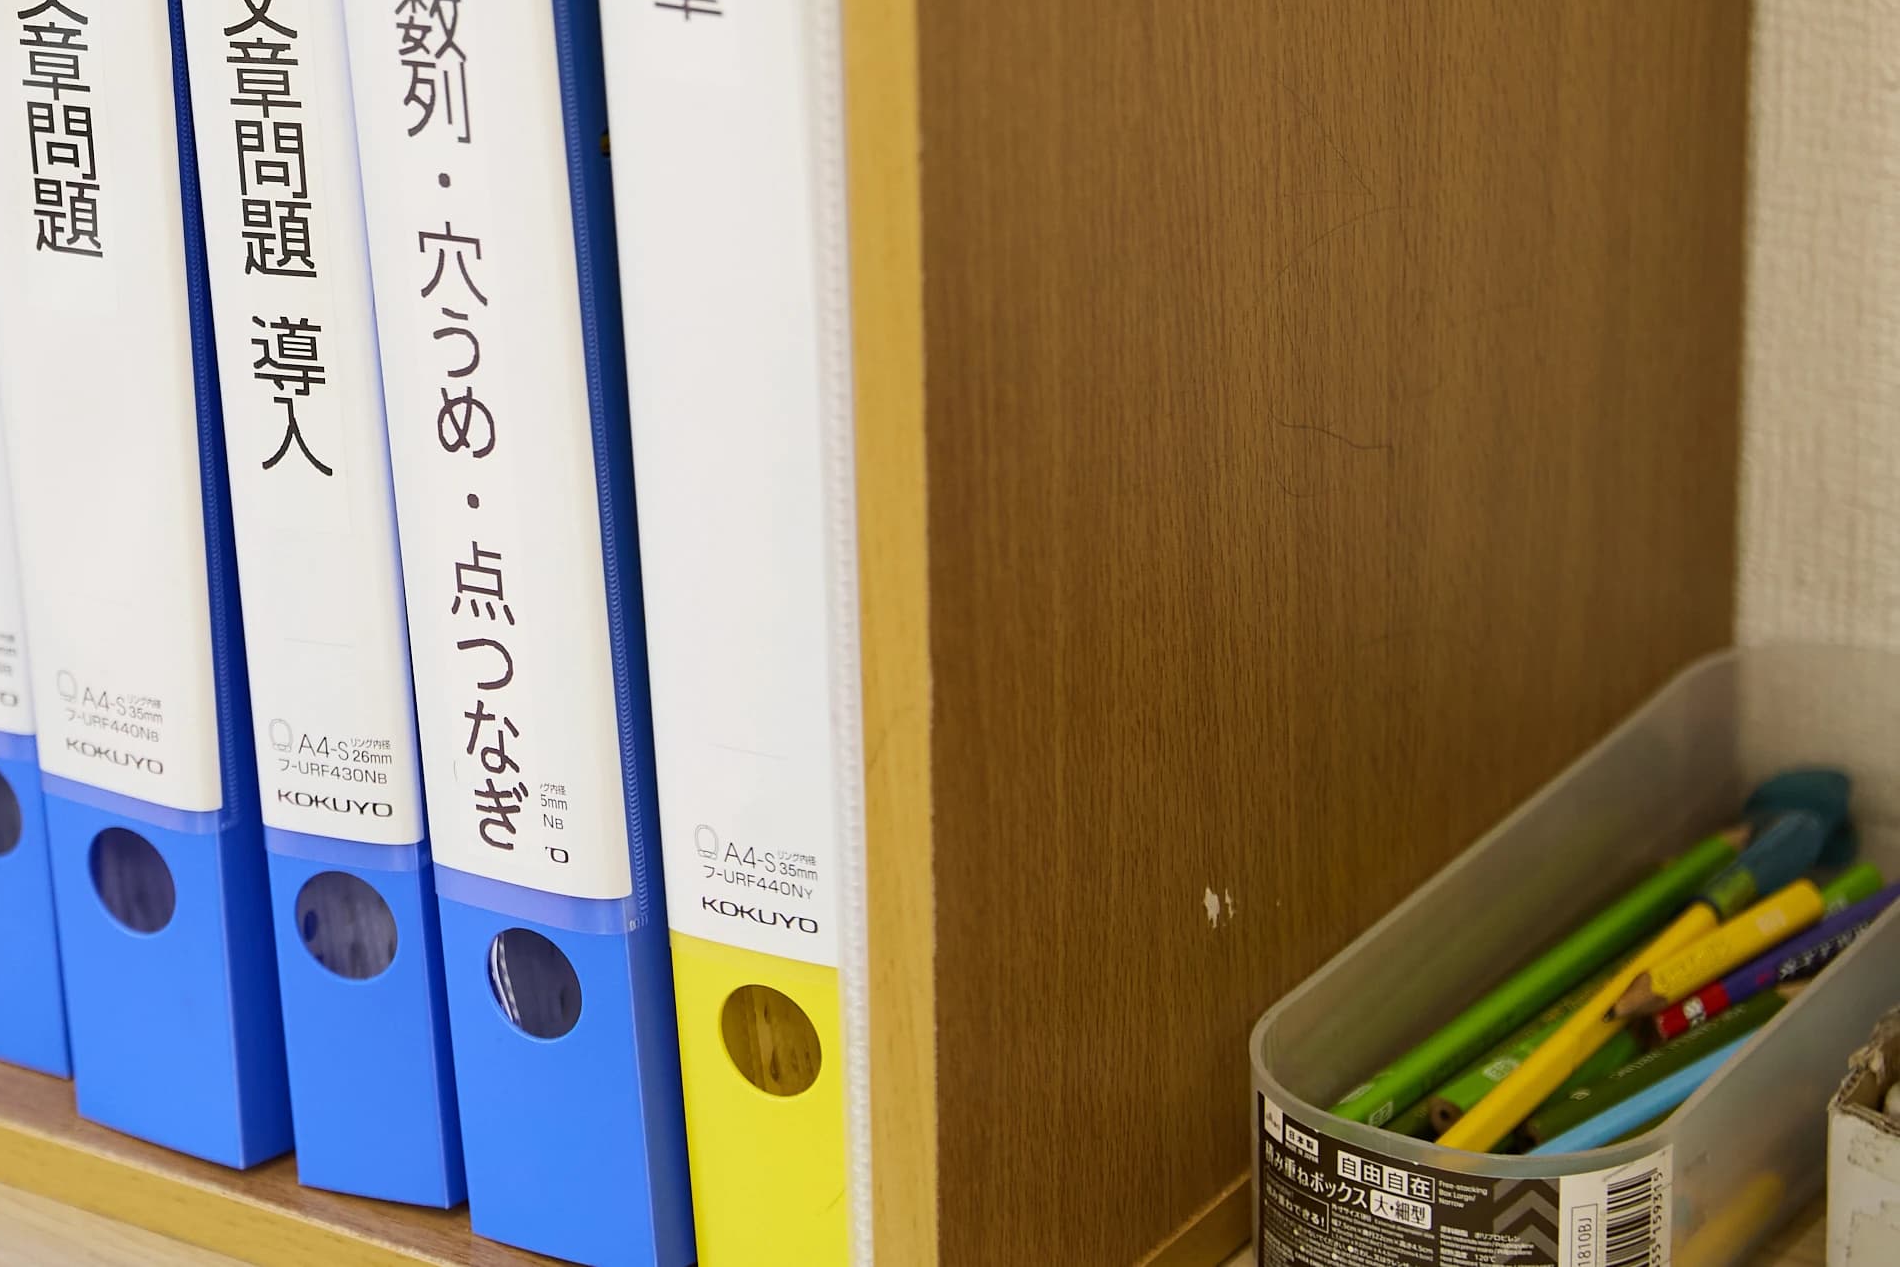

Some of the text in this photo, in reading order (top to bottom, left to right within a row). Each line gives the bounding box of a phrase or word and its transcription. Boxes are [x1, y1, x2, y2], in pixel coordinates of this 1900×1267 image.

[251, 314, 334, 478] 導入
[82, 686, 127, 717] A4-S
[128, 705, 164, 725] 35mm
[65, 737, 164, 775] KOKUYO
[298, 733, 350, 762] A4-S
[350, 737, 392, 751] リング内径
[351, 748, 393, 766] 26mm
[277, 788, 393, 818] KOKUYO
[539, 782, 567, 797] グ内径
[539, 793, 568, 812] 5mm
[724, 841, 777, 874] A4-S
[776, 849, 818, 867] リング内径
[778, 861, 820, 882] 35mm
[701, 895, 820, 934] KOKUYO
[1264, 1139, 1368, 1209] 積み重ねボックス
[1341, 1156, 1431, 1199] 自由自在
[1373, 1195, 1426, 1225] 大・細型
